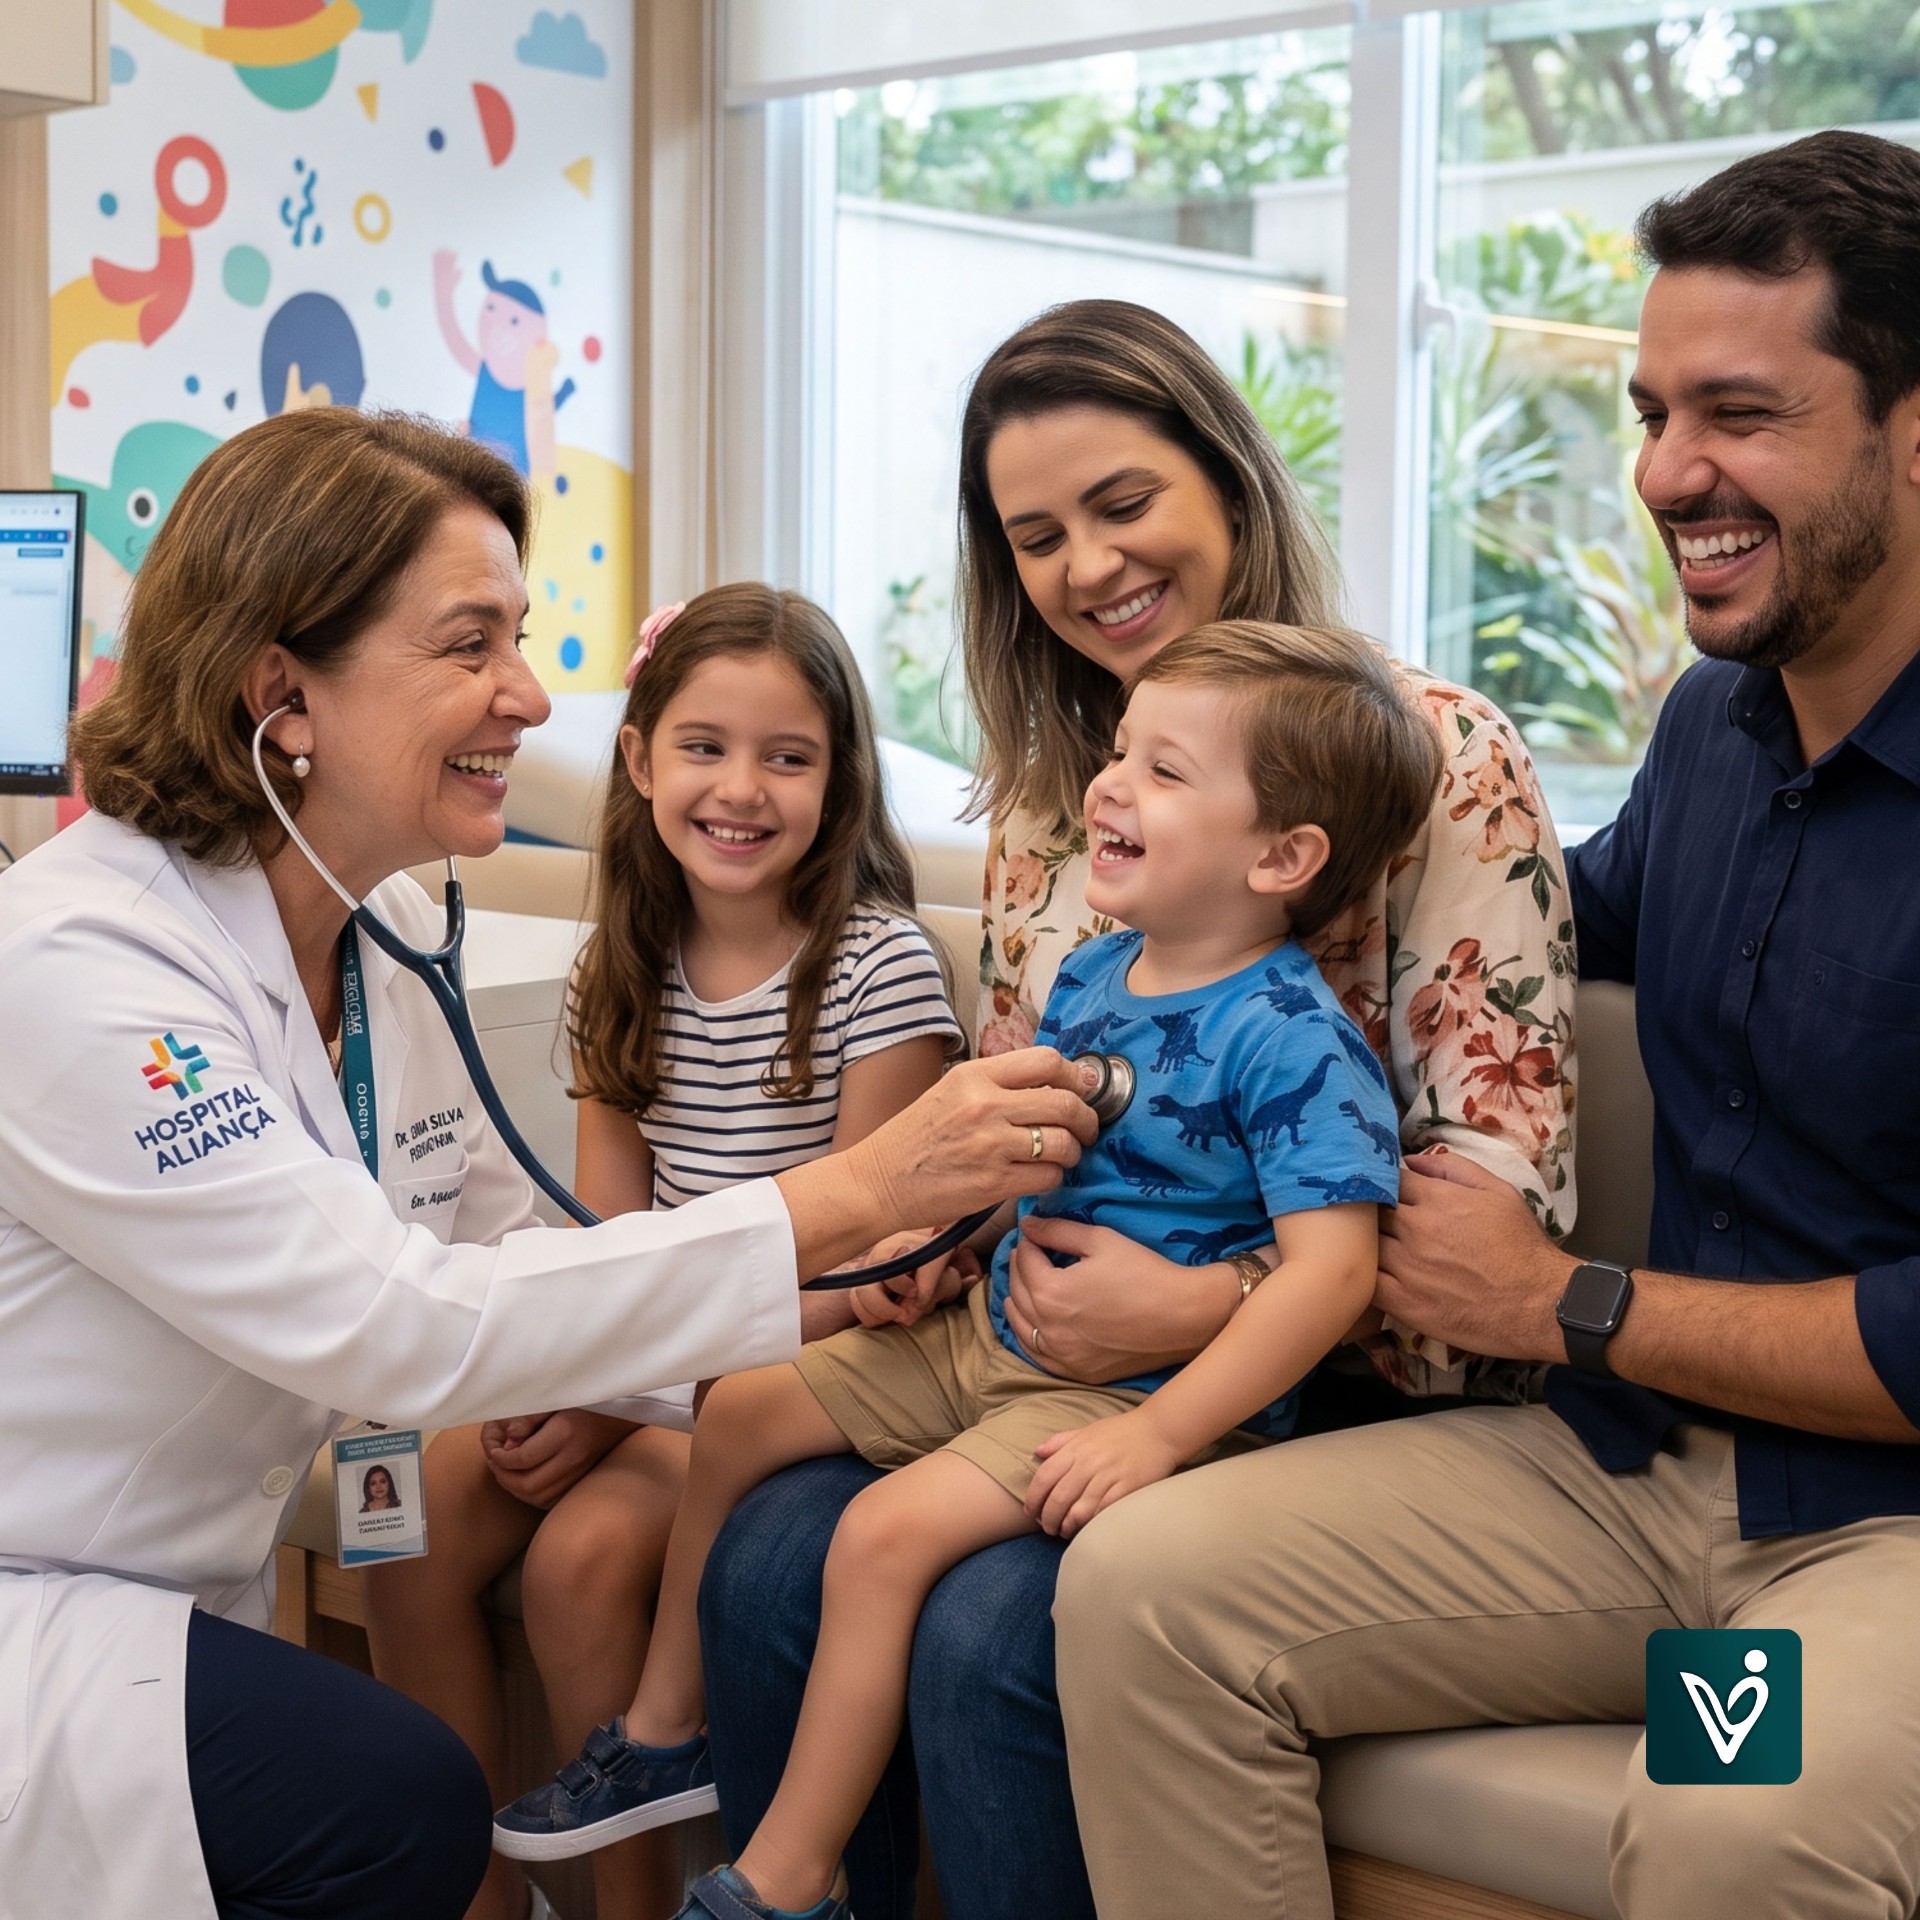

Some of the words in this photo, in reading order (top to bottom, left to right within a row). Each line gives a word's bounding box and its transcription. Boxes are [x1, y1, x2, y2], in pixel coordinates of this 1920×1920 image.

[134, 1083, 261, 1150] HOSPITAL
[157, 1106, 277, 1174] ALIANÇA
[429, 1107, 464, 1130] SILVA
